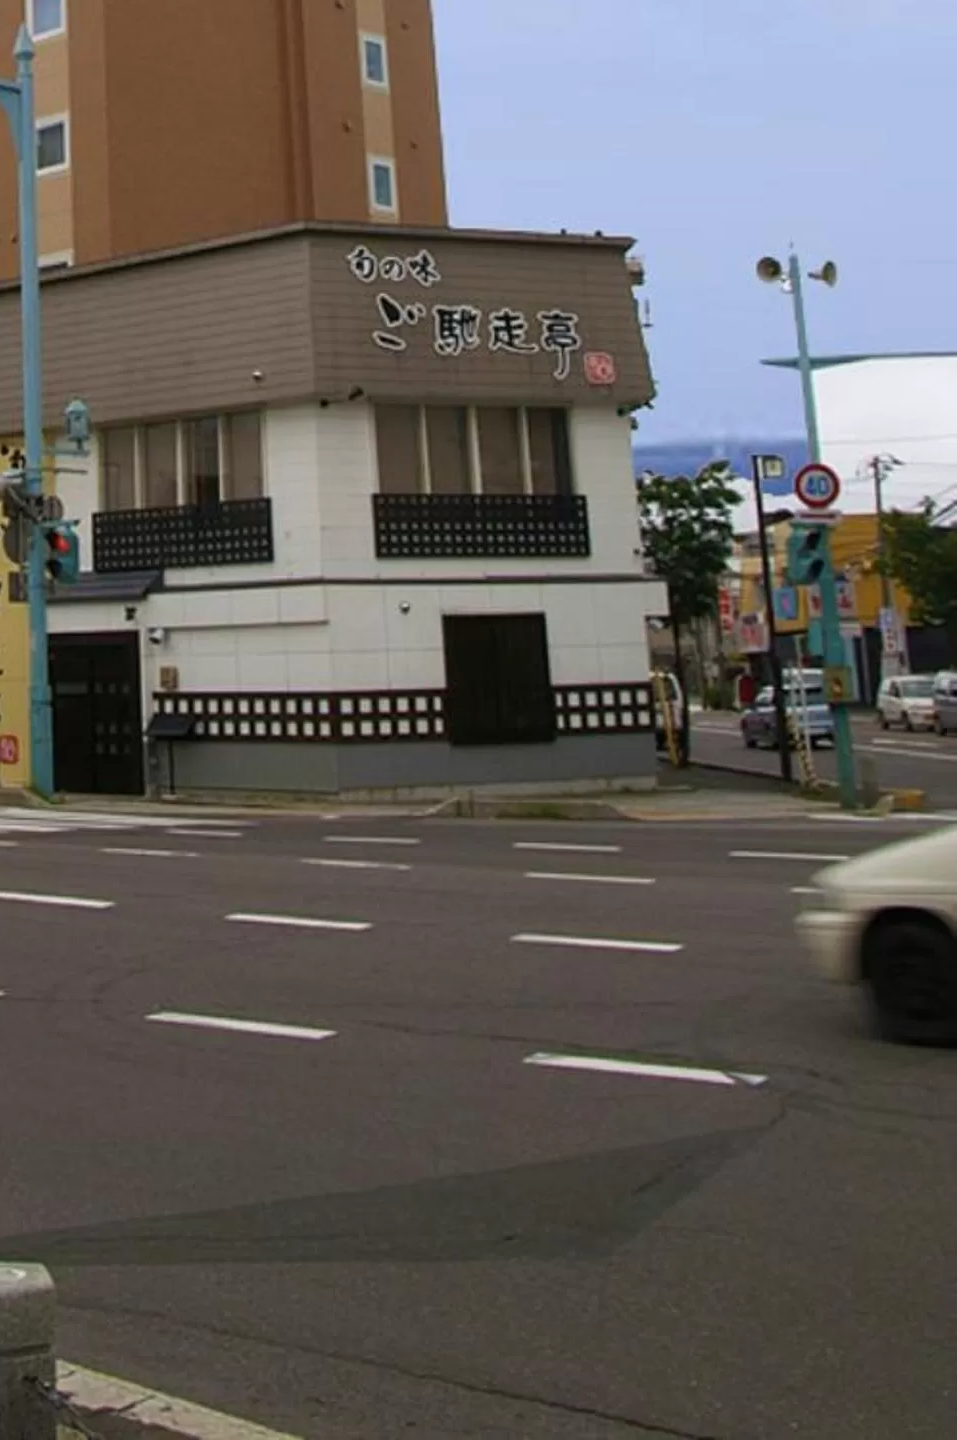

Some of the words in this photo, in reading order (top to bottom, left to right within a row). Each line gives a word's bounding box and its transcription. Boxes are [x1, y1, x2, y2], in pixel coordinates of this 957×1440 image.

[347, 245, 441, 283] 旬の味
[373, 293, 582, 381] ご馳走亭
[806, 475, 831, 496] 40
